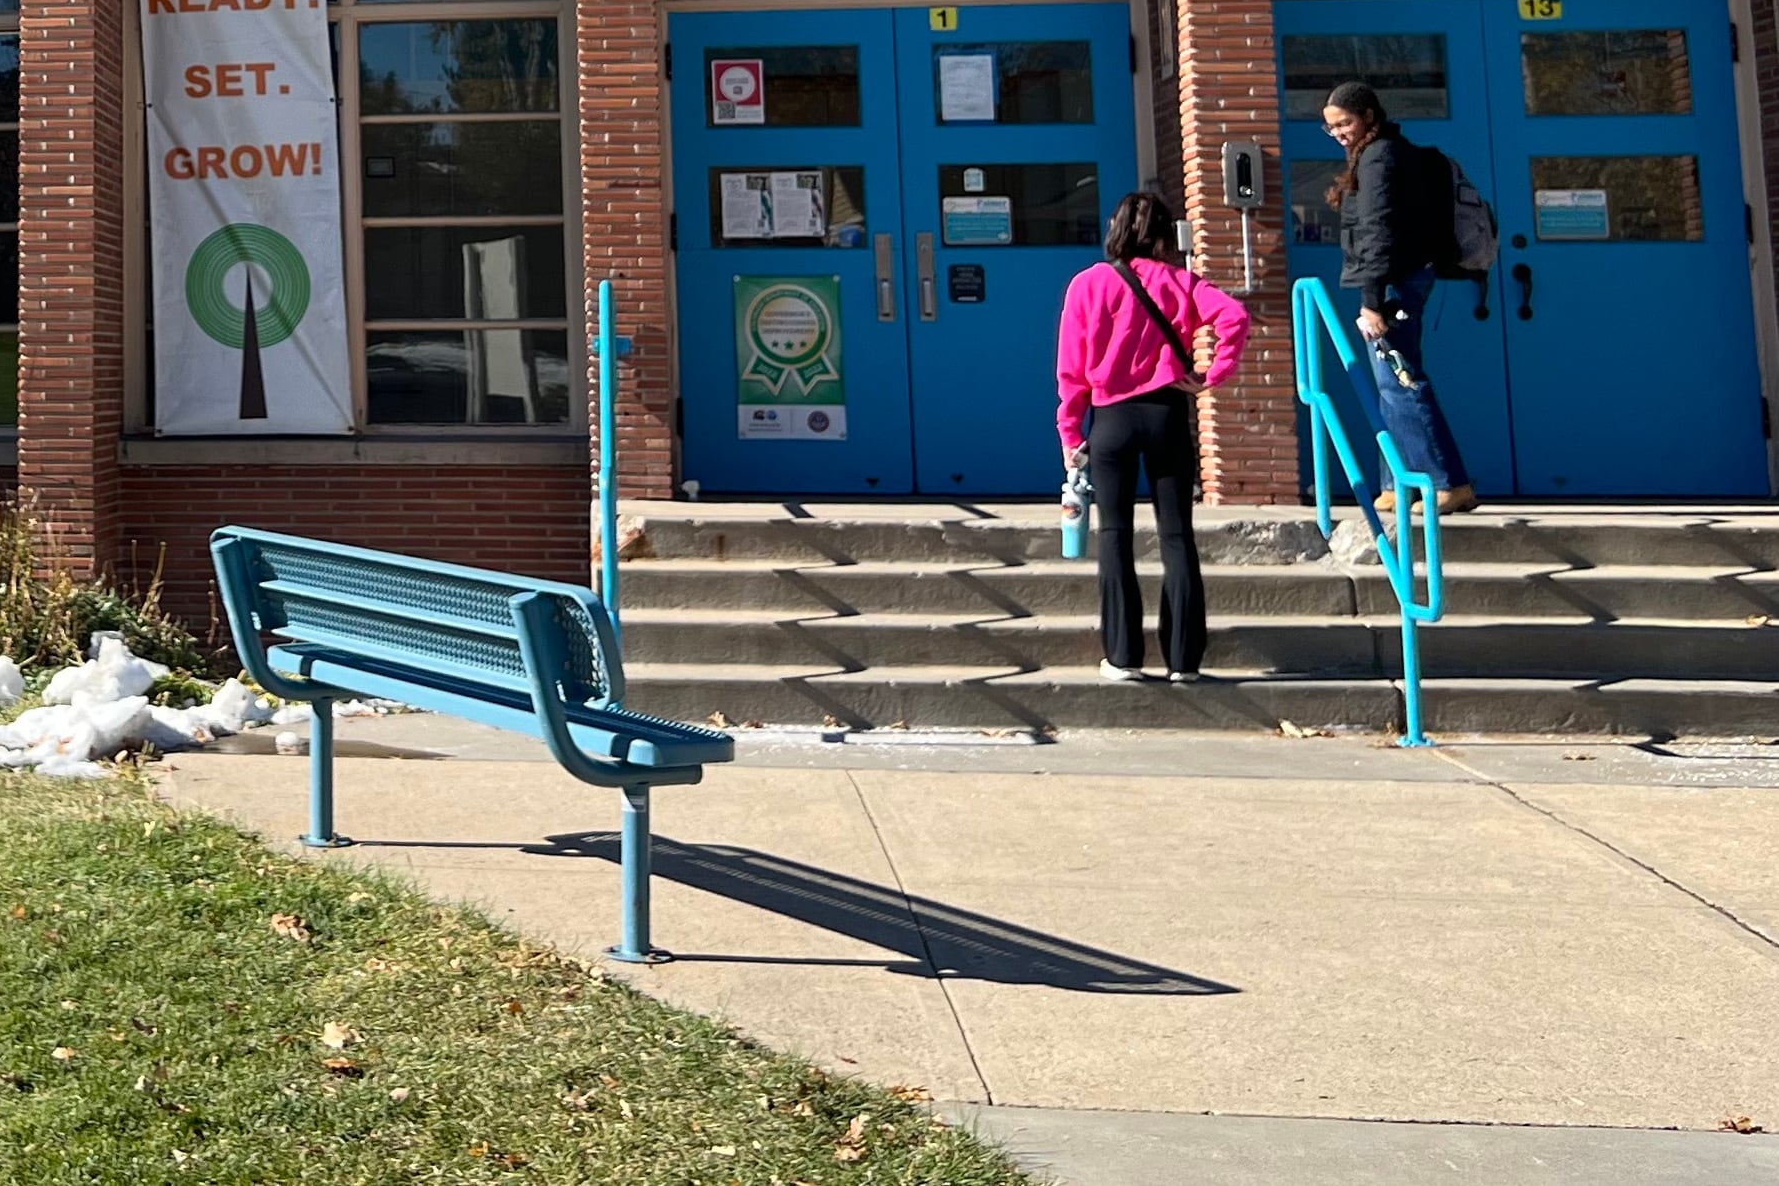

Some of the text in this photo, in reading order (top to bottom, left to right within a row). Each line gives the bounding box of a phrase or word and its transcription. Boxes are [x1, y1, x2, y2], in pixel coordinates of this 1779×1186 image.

[936, 10, 947, 28] 1
[184, 63, 290, 99] SET.
[165, 143, 323, 180] GROW!
